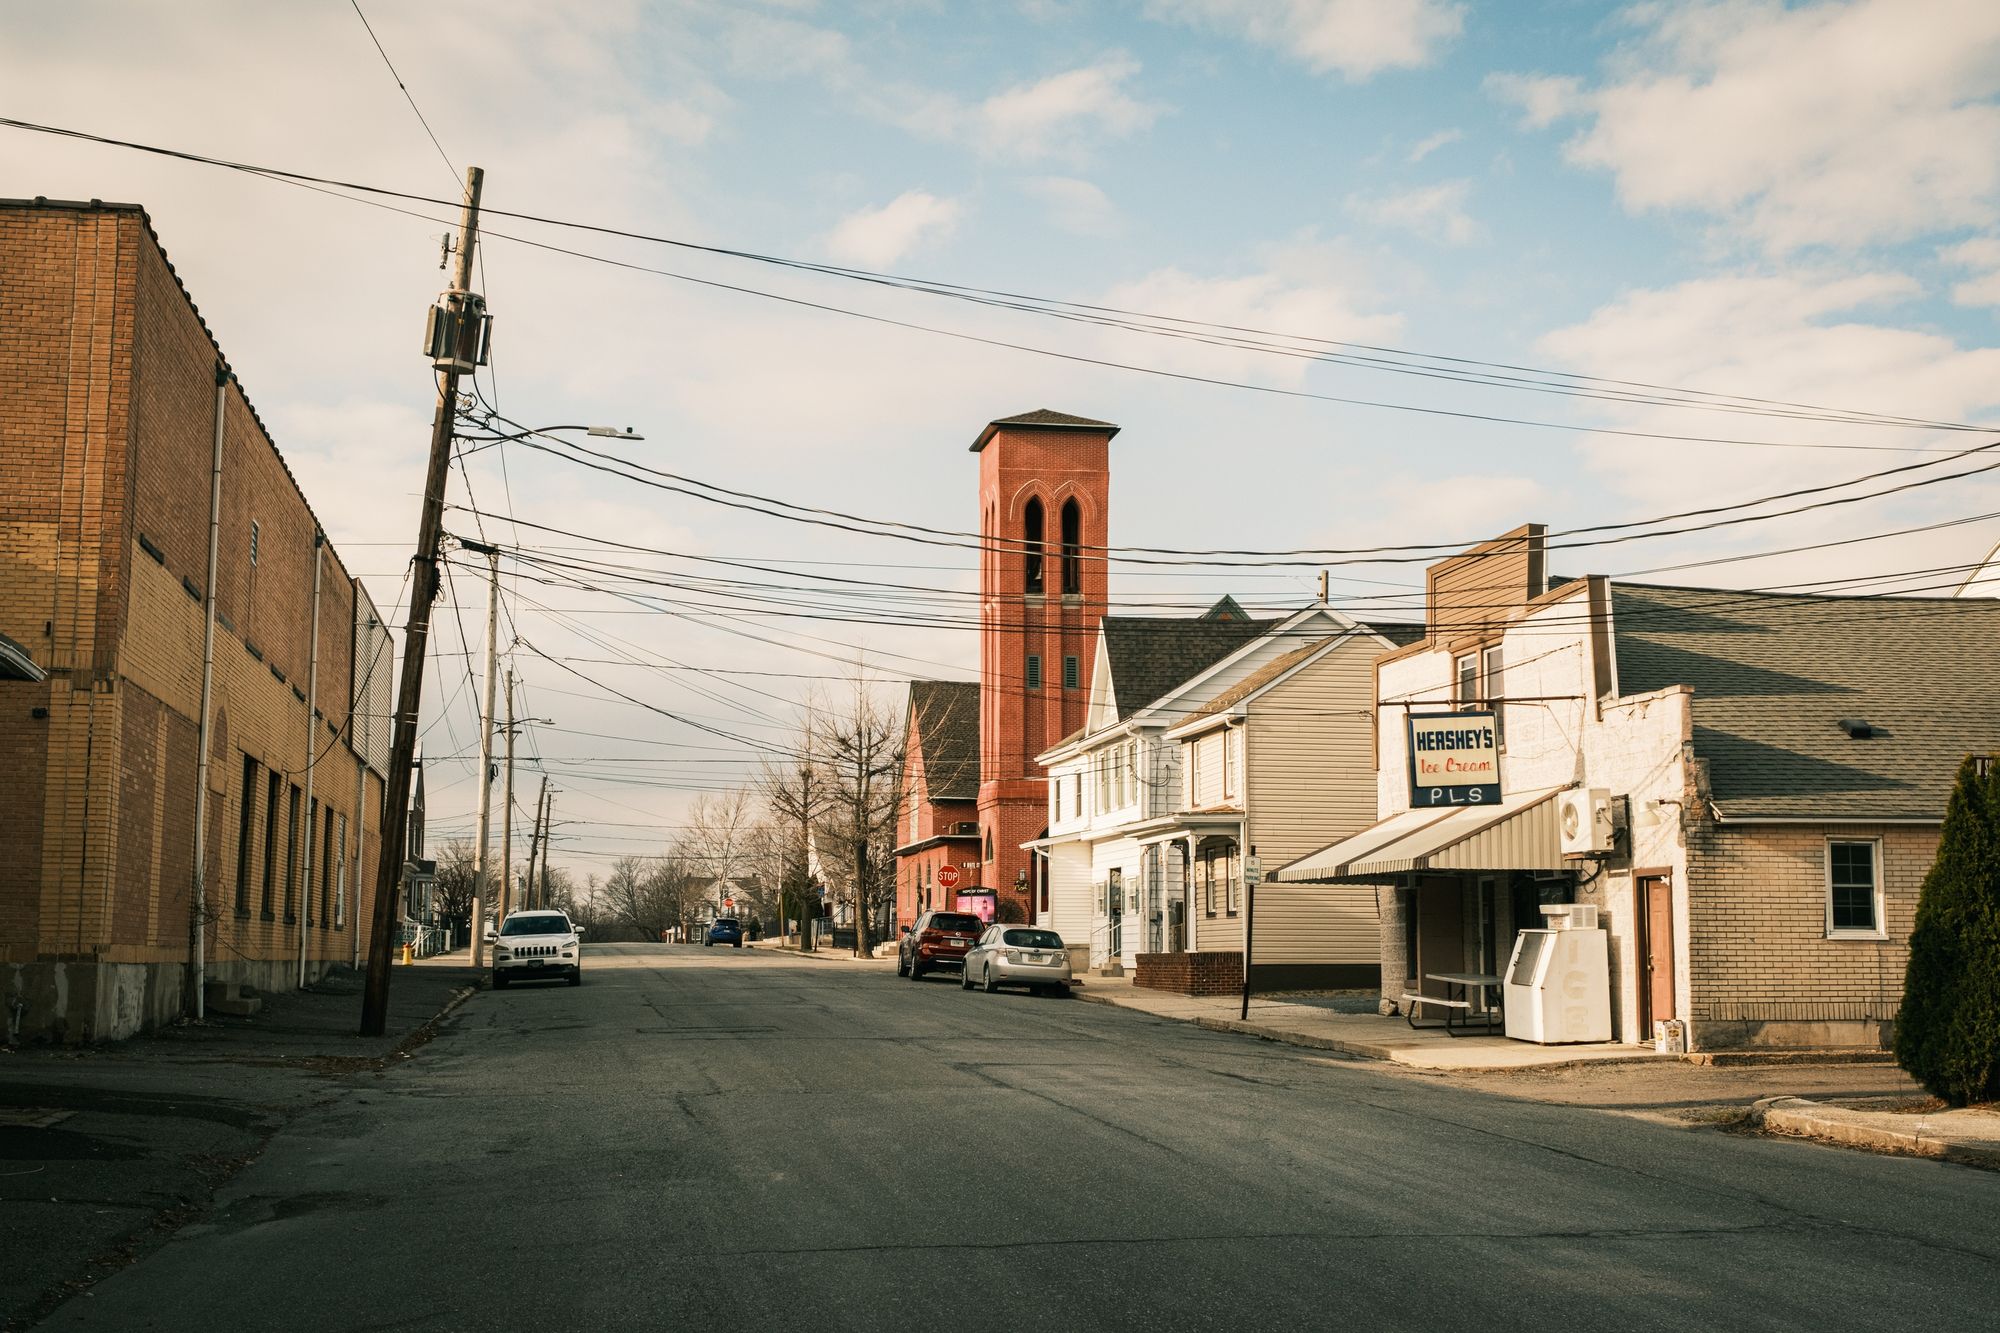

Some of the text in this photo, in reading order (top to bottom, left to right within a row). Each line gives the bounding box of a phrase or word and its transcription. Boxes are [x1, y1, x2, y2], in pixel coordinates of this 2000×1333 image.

[1417, 726, 1493, 751] HERSHEY'S
[1420, 757, 1492, 774] Ice Cream
[1431, 787, 1482, 804] PLS
[938, 872, 958, 881] STOP
